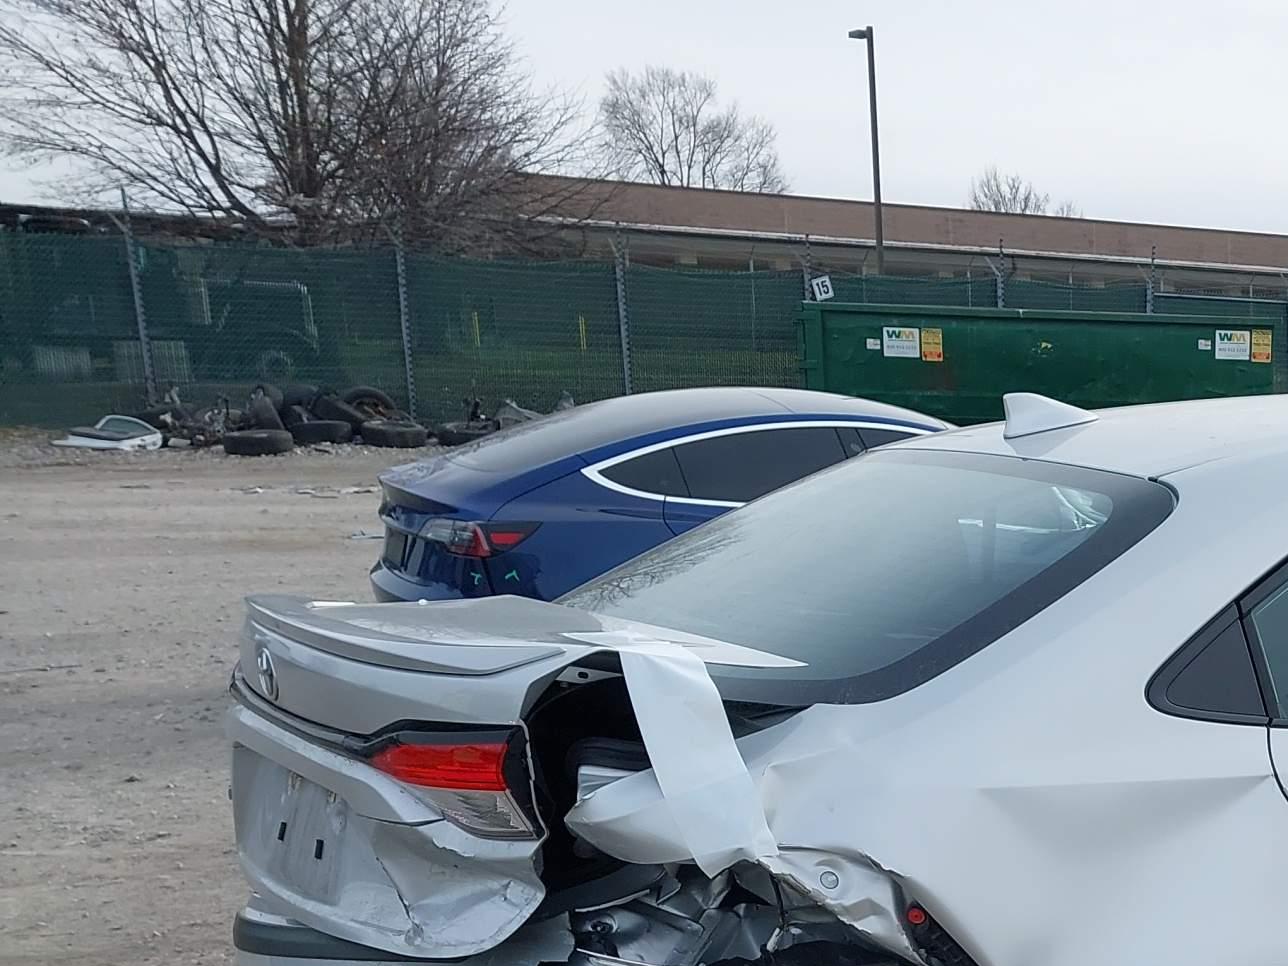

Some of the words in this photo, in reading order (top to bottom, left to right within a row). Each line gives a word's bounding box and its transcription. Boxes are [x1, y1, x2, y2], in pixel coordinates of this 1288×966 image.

[815, 279, 830, 297] 15
[886, 329, 915, 339] WM
[1218, 332, 1246, 342] WM
